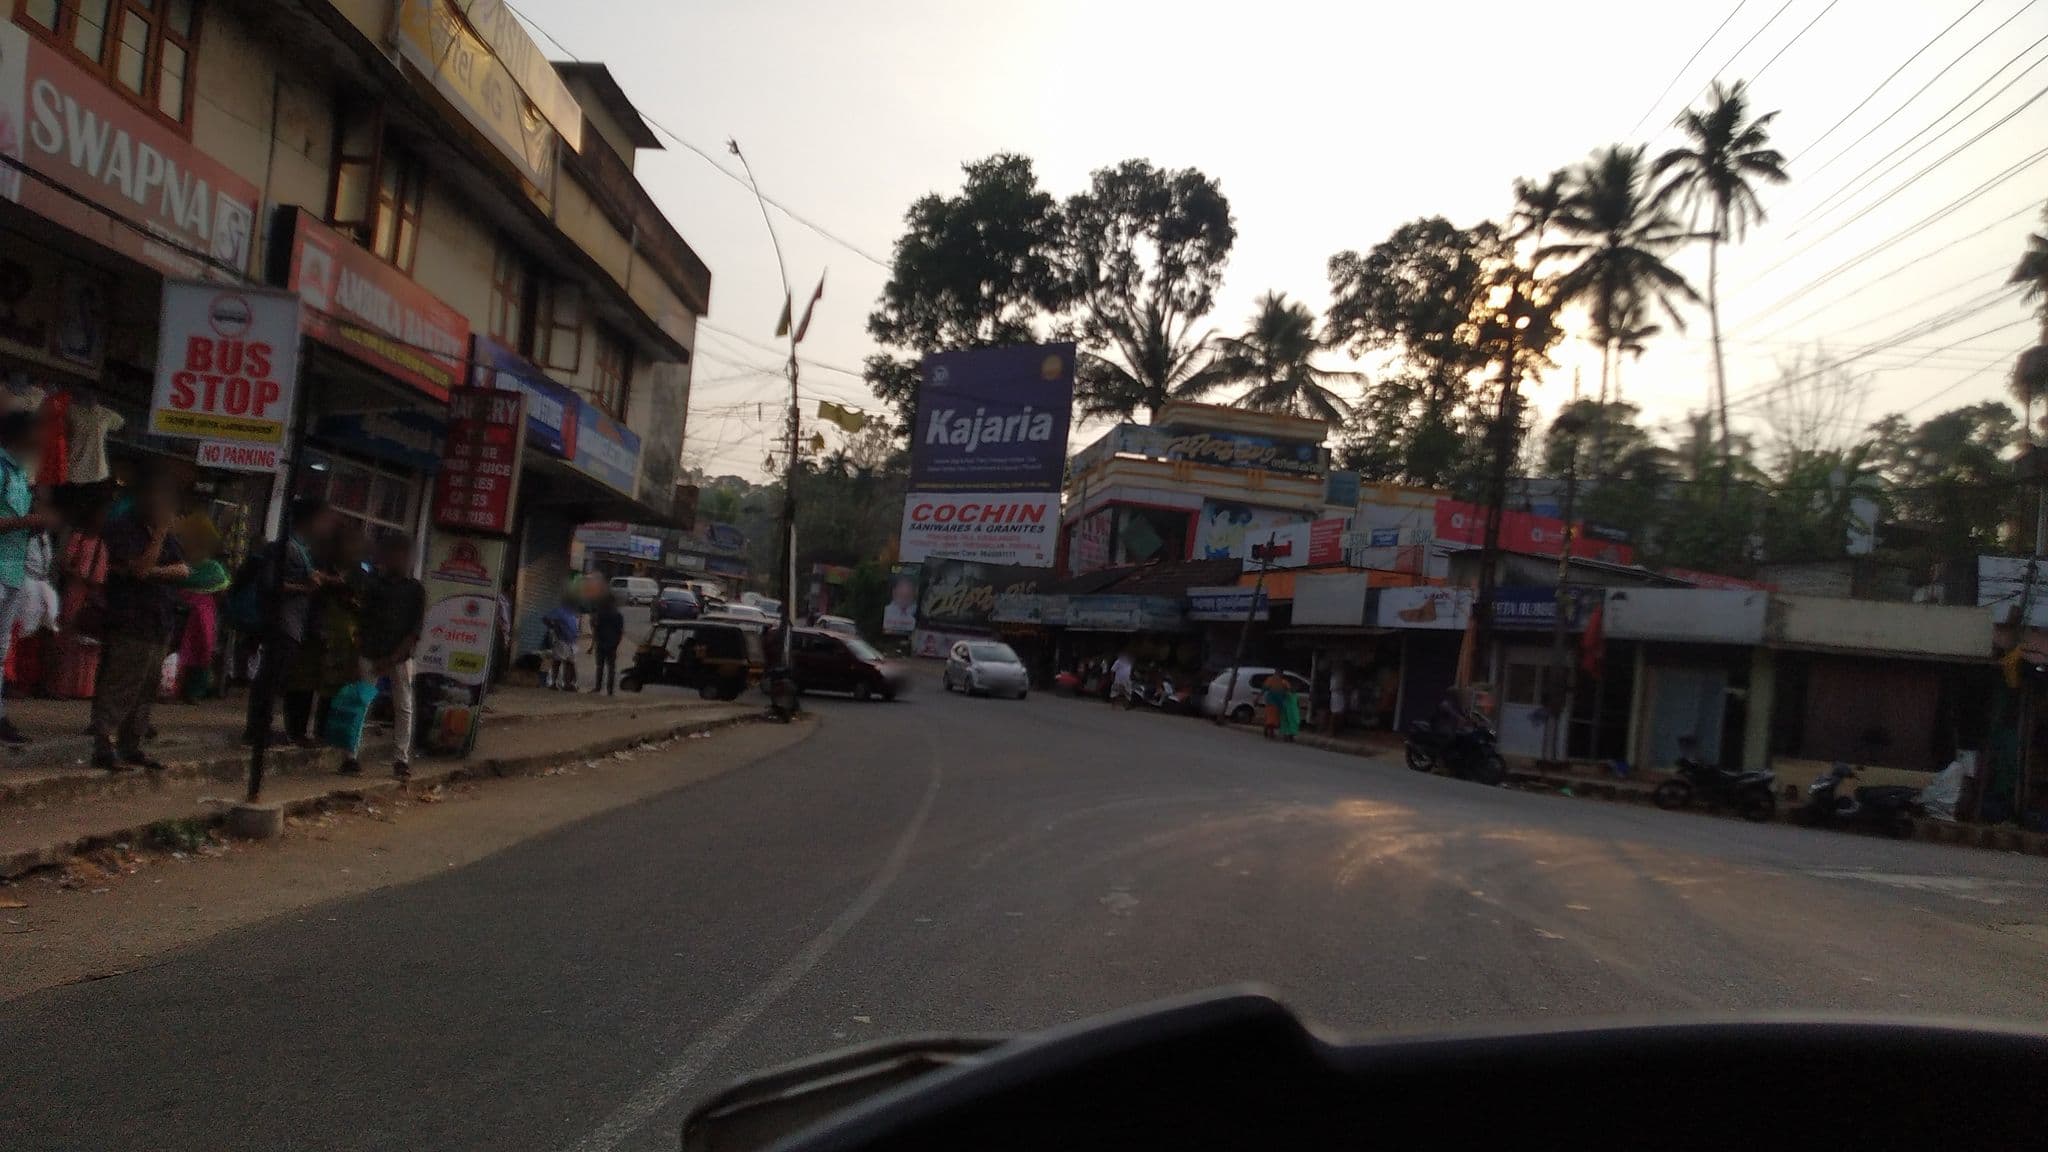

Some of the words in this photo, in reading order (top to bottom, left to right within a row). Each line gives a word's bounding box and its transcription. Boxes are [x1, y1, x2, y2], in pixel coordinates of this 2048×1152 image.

[31, 79, 210, 240] SWAPNA
[185, 335, 273, 378] BUS
[169, 371, 280, 417] STOP
[925, 406, 1054, 453] Kajaria
[203, 445, 222, 463] NO
[223, 445, 276, 468] PARKING
[478, 462, 512, 477] JUICE
[449, 490, 488, 507] CAES
[911, 503, 1047, 523] COCHIN
[909, 523, 971, 533] SANIWARES
[985, 524, 1045, 534] GRANITES
[446, 631, 478, 645] airtel
